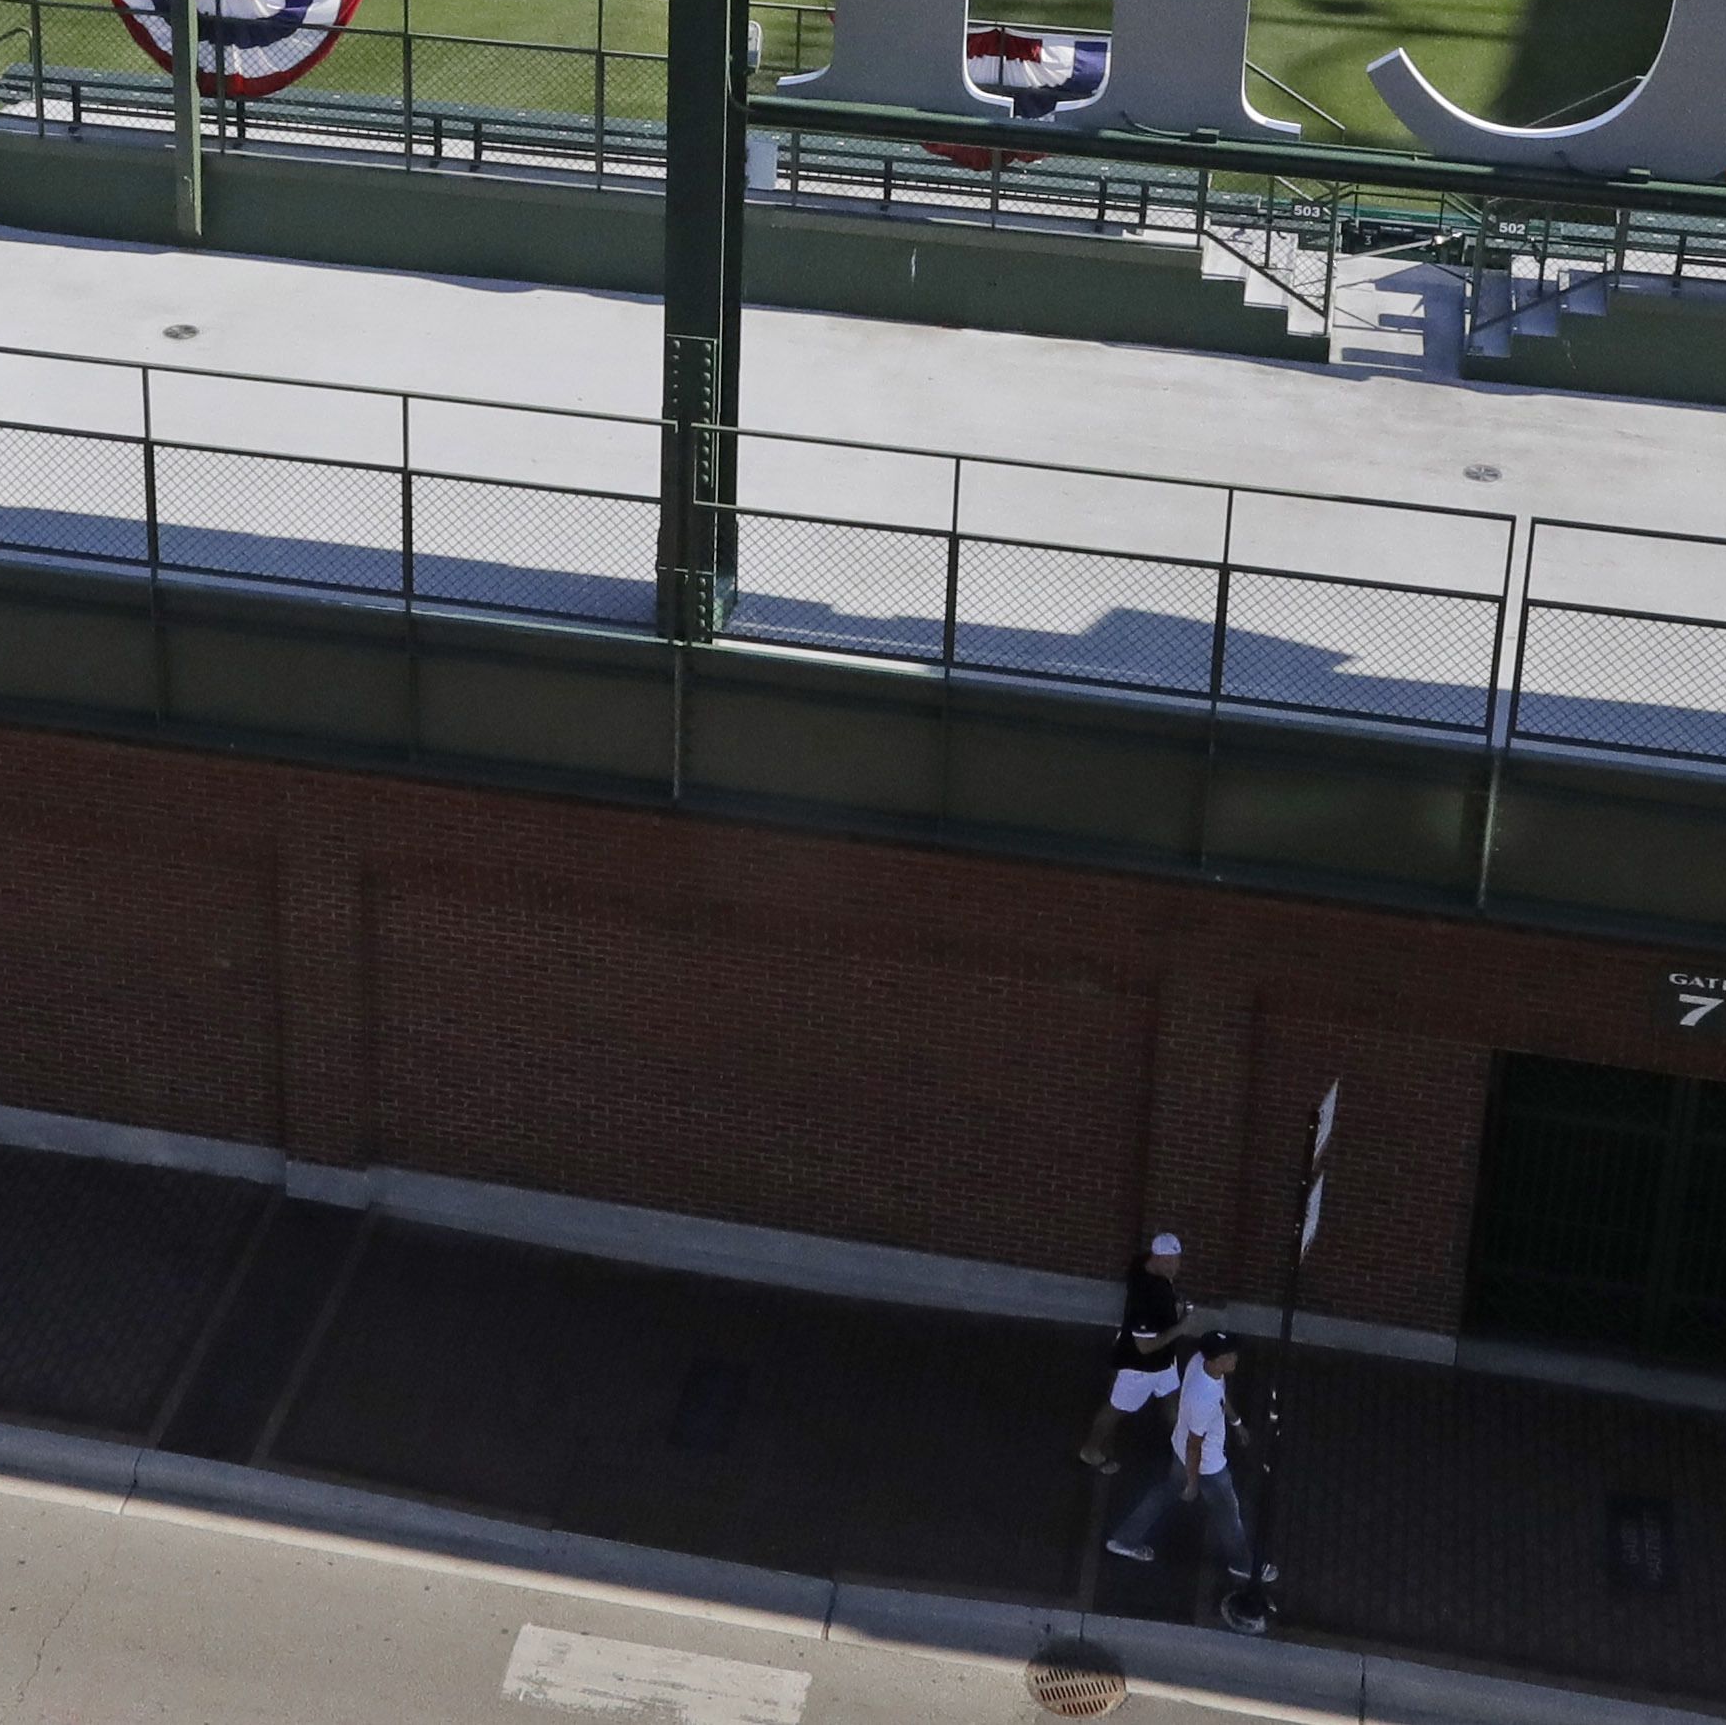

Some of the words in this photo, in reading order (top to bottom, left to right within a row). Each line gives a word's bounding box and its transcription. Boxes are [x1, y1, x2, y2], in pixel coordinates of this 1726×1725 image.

[1293, 205, 1322, 218] 503
[1498, 222, 1526, 235] 502
[1678, 992, 1725, 1027] 7
